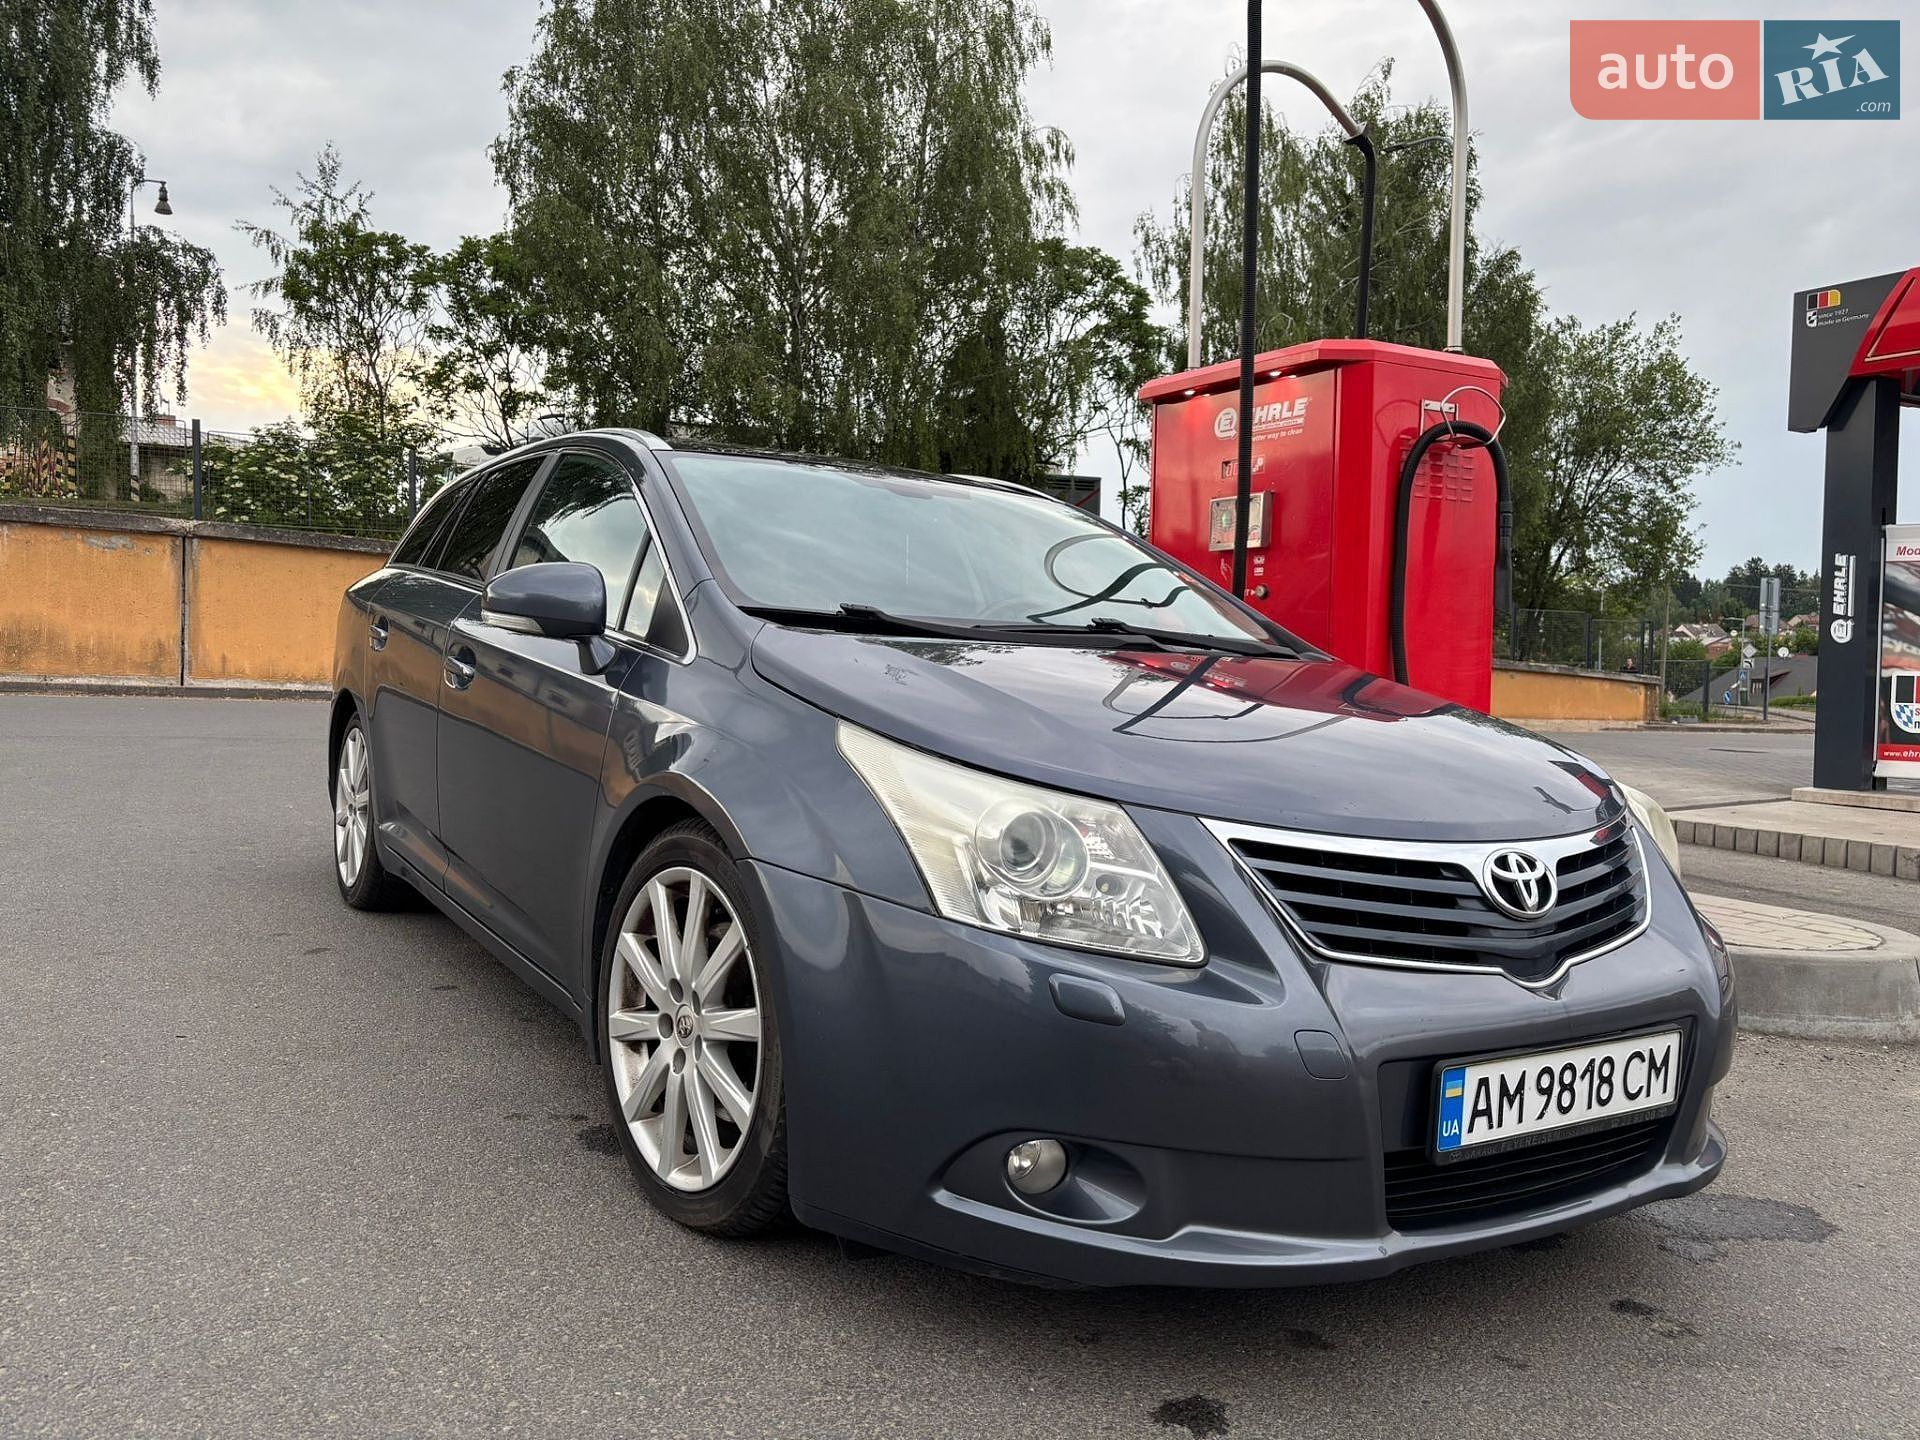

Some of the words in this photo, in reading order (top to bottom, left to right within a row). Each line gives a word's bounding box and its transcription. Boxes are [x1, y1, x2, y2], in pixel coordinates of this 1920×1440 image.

[1253, 397, 1309, 424] HRLE
[1832, 552, 1849, 616] EHRLE
[1467, 1070, 1527, 1134] AM
[1536, 1055, 1616, 1121] 9818
[1623, 1044, 1672, 1102] CM
[1442, 1119, 1460, 1138] UA
